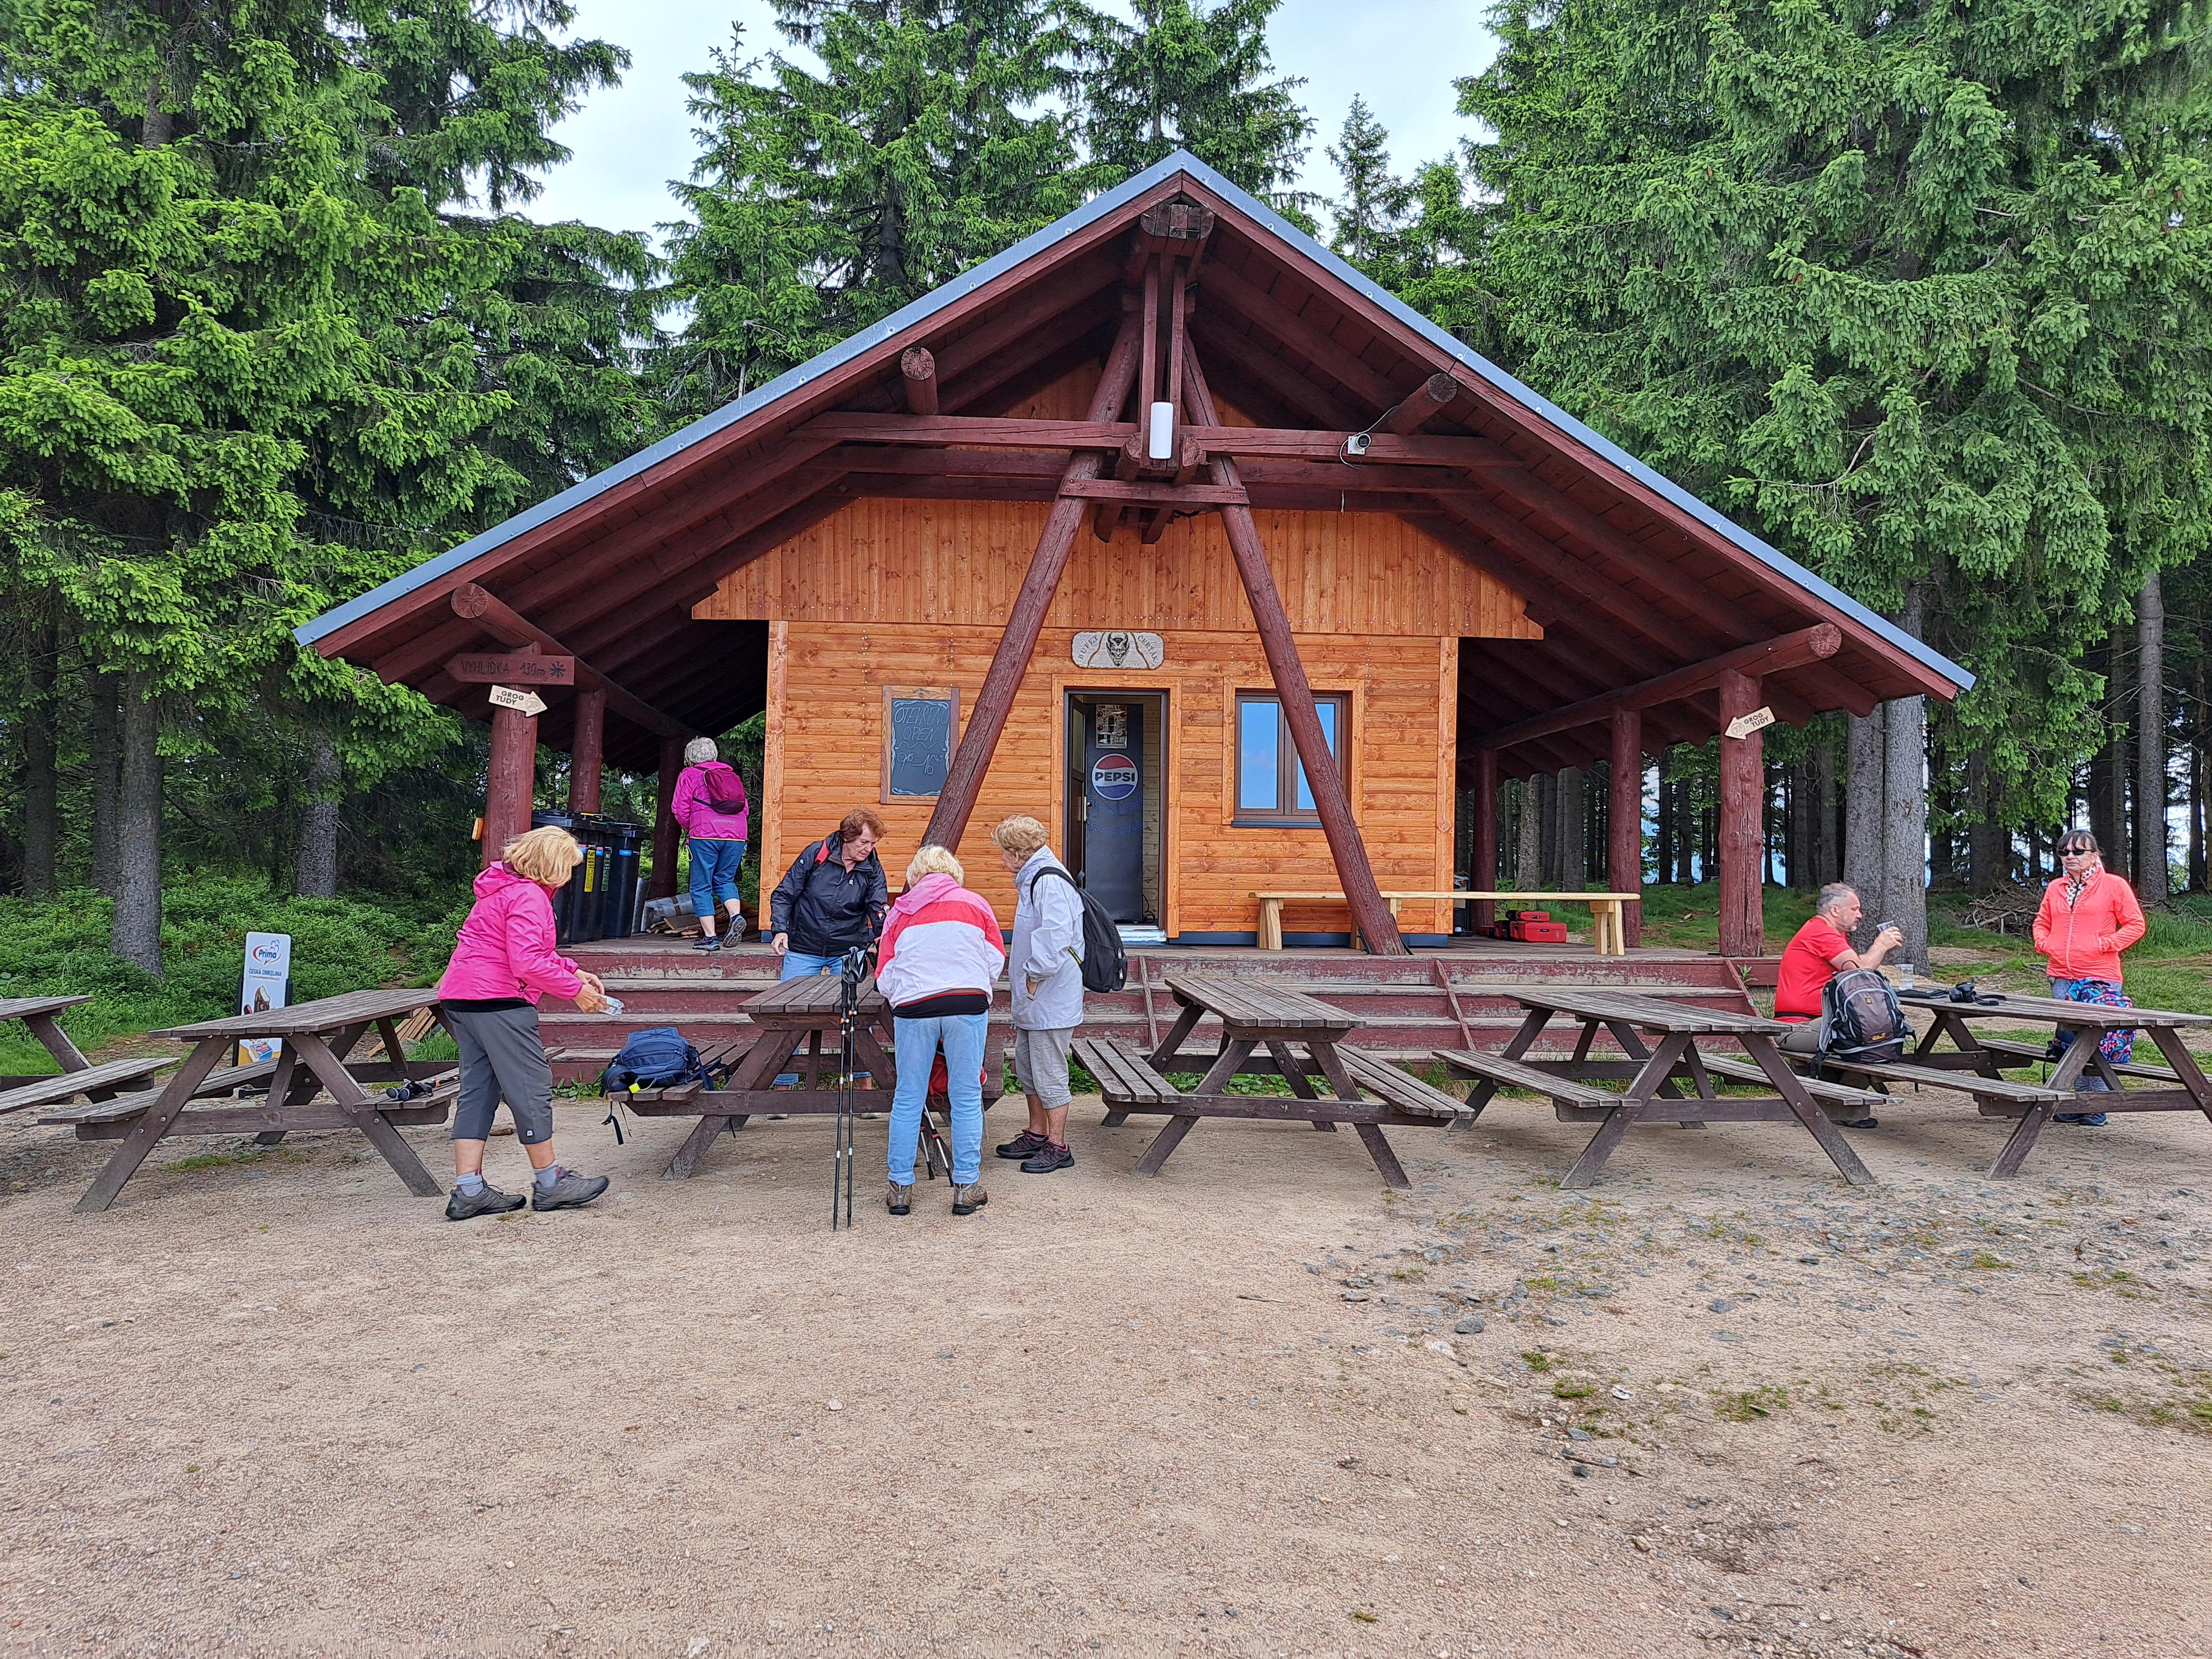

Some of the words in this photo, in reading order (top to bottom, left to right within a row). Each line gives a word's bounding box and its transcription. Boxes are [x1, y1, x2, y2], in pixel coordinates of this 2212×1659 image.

[1078, 635, 1099, 660] BUFET
[461, 657, 509, 674] VYHLÍDKA
[496, 695, 518, 706] TUDY
[502, 691, 524, 701] GROG
[1744, 713, 1764, 724] GROG
[1751, 716, 1769, 728] TUDY
[903, 727, 937, 742] OPEN
[1094, 772, 1135, 782] PEPSI
[258, 949, 277, 959] Prima
